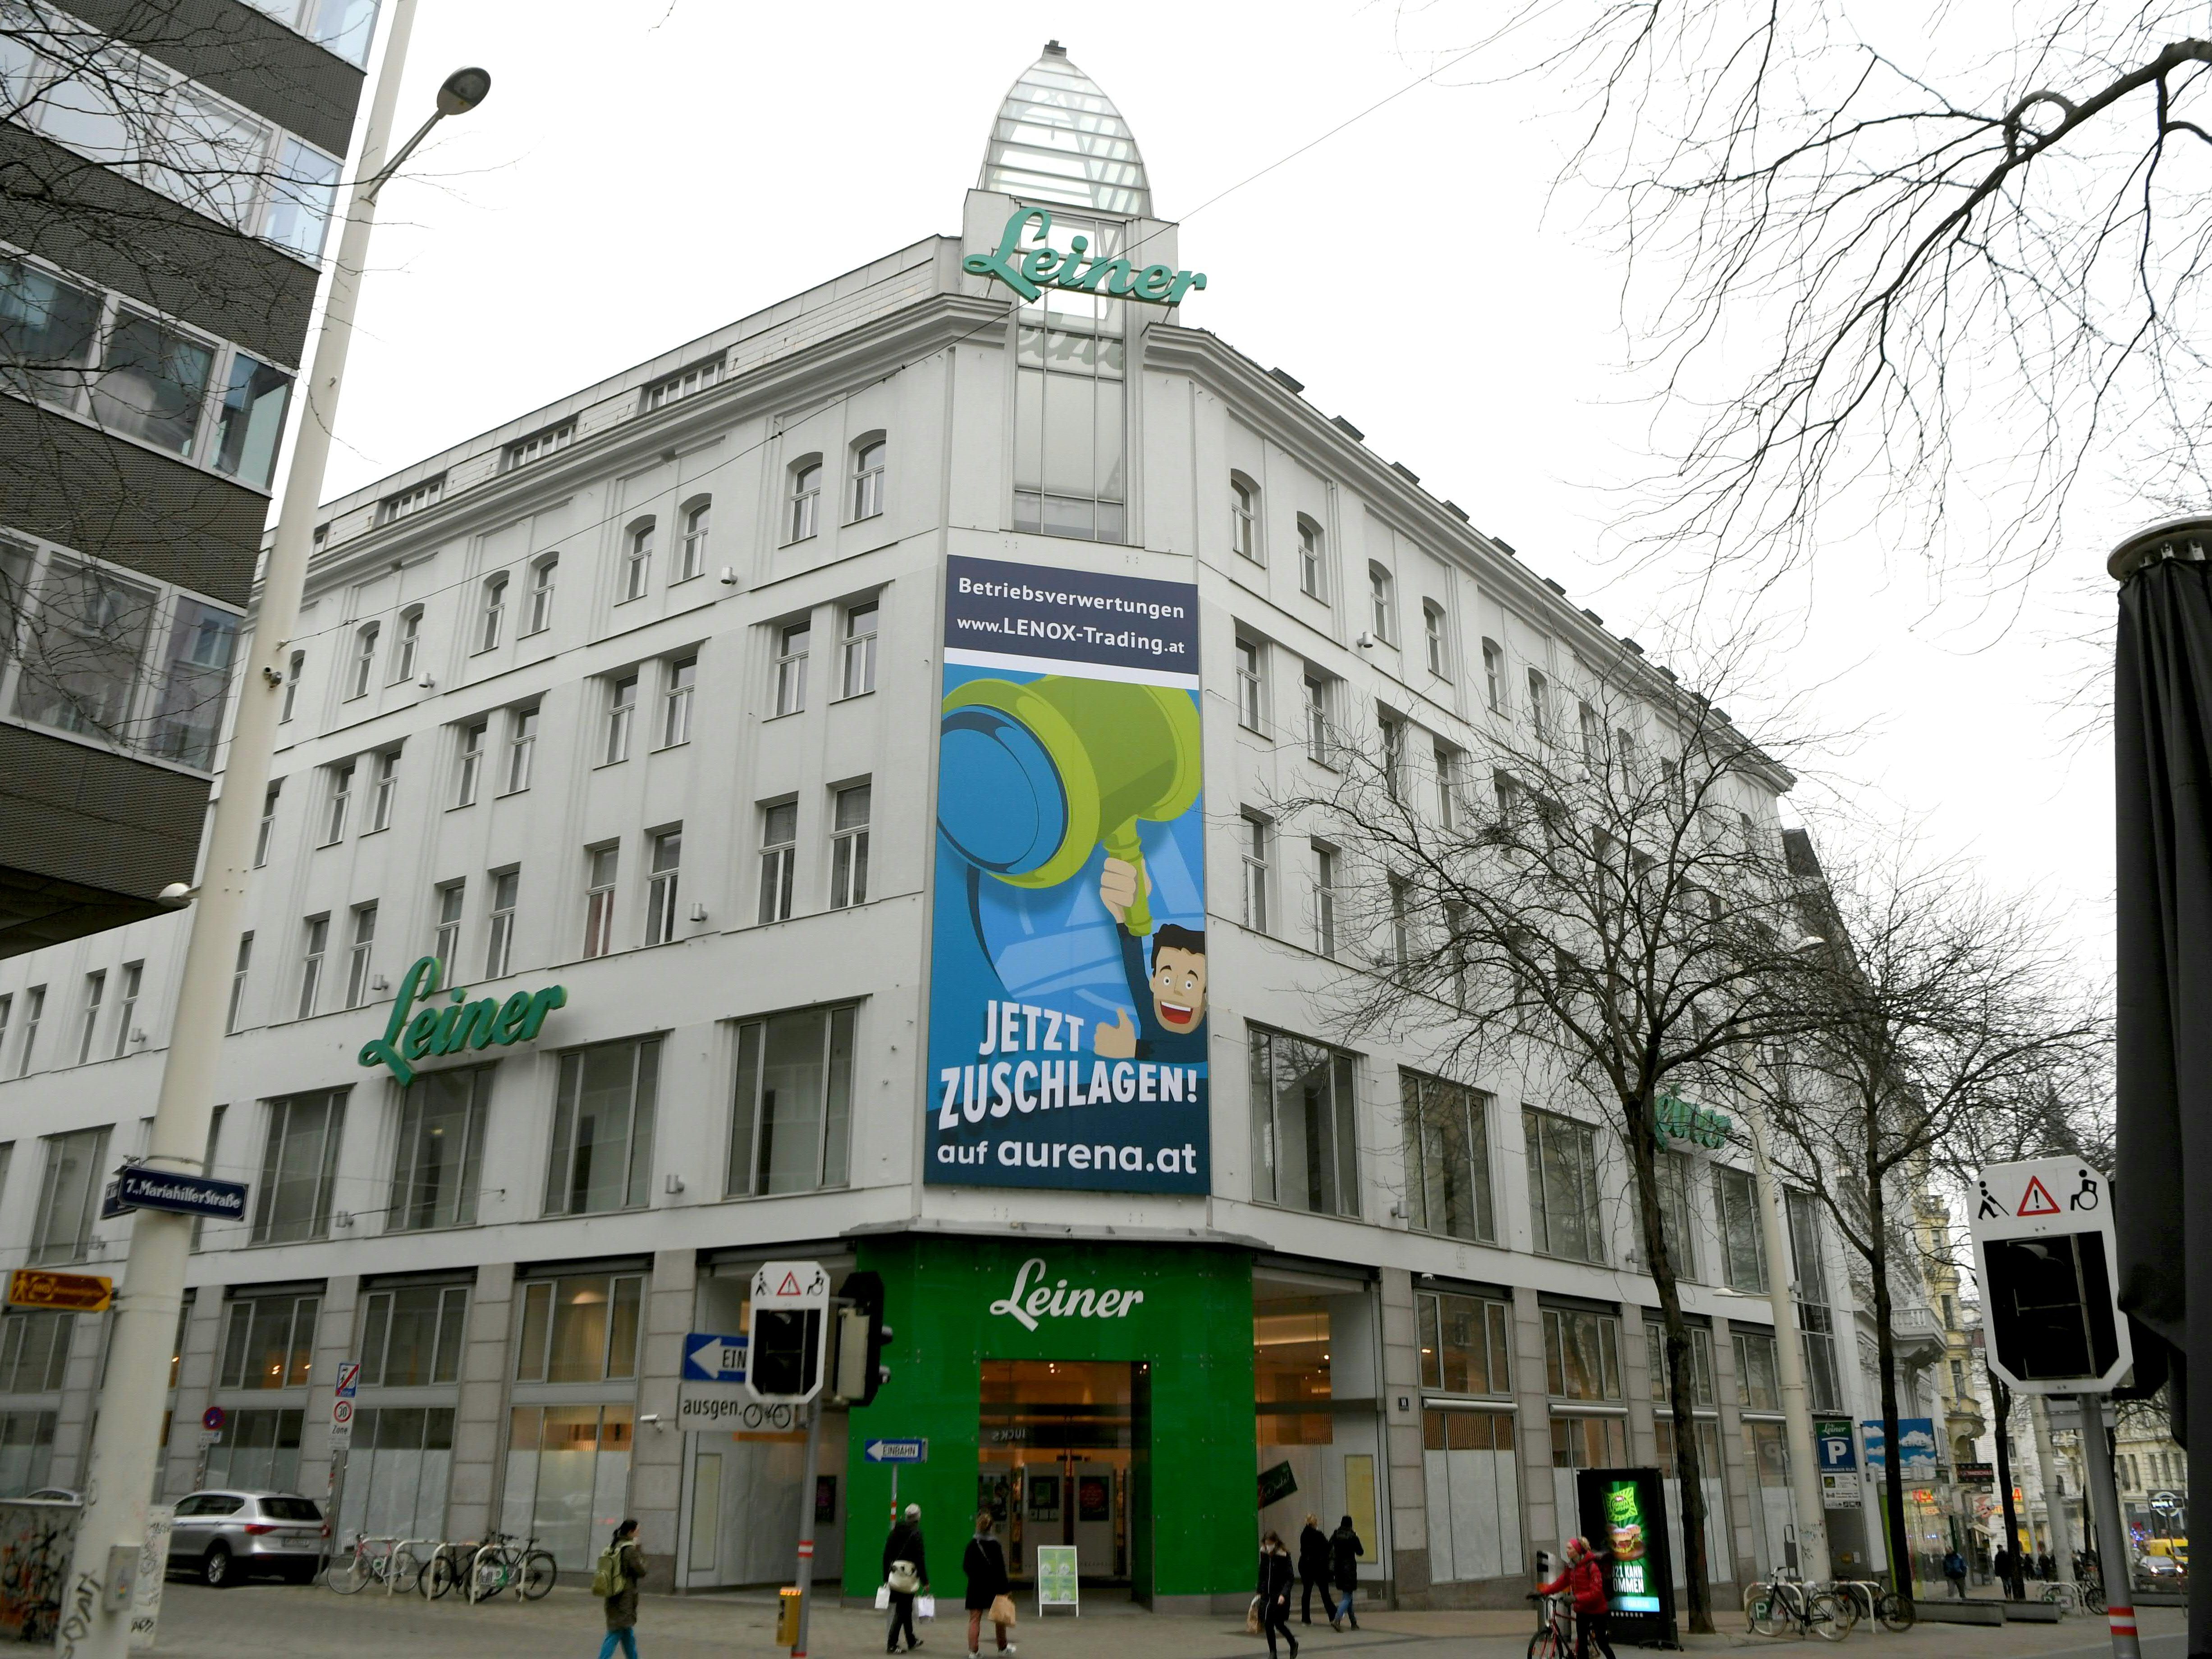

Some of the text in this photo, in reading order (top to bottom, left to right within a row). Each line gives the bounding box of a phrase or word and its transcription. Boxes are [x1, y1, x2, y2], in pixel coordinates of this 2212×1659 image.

[962, 206, 1207, 308] Leiner
[958, 577, 1185, 619] Betriebsverwertungen
[957, 617, 1185, 655] www.LENOX-Trading.at
[357, 955, 568, 1088] Leiner
[978, 999, 1084, 1055] JETZT
[938, 1060, 1197, 1131] ZUSCHLAGEN!
[1653, 1082, 1732, 1154] einer
[937, 1140, 1197, 1175] auf aurena.at
[989, 1257, 1144, 1332] Leiner
[722, 1348, 746, 1369] EIN
[339, 1406, 348, 1418] 30
[683, 1399, 742, 1420] ausgen.
[332, 1425, 348, 1434] Zone
[882, 1444, 916, 1455] EINBAHN
[1827, 1441, 1847, 1464] P
[1613, 1578, 1644, 1593] OMMEN
[1624, 1565, 1643, 1578] KANN
[1755, 1602, 1767, 1619] P
